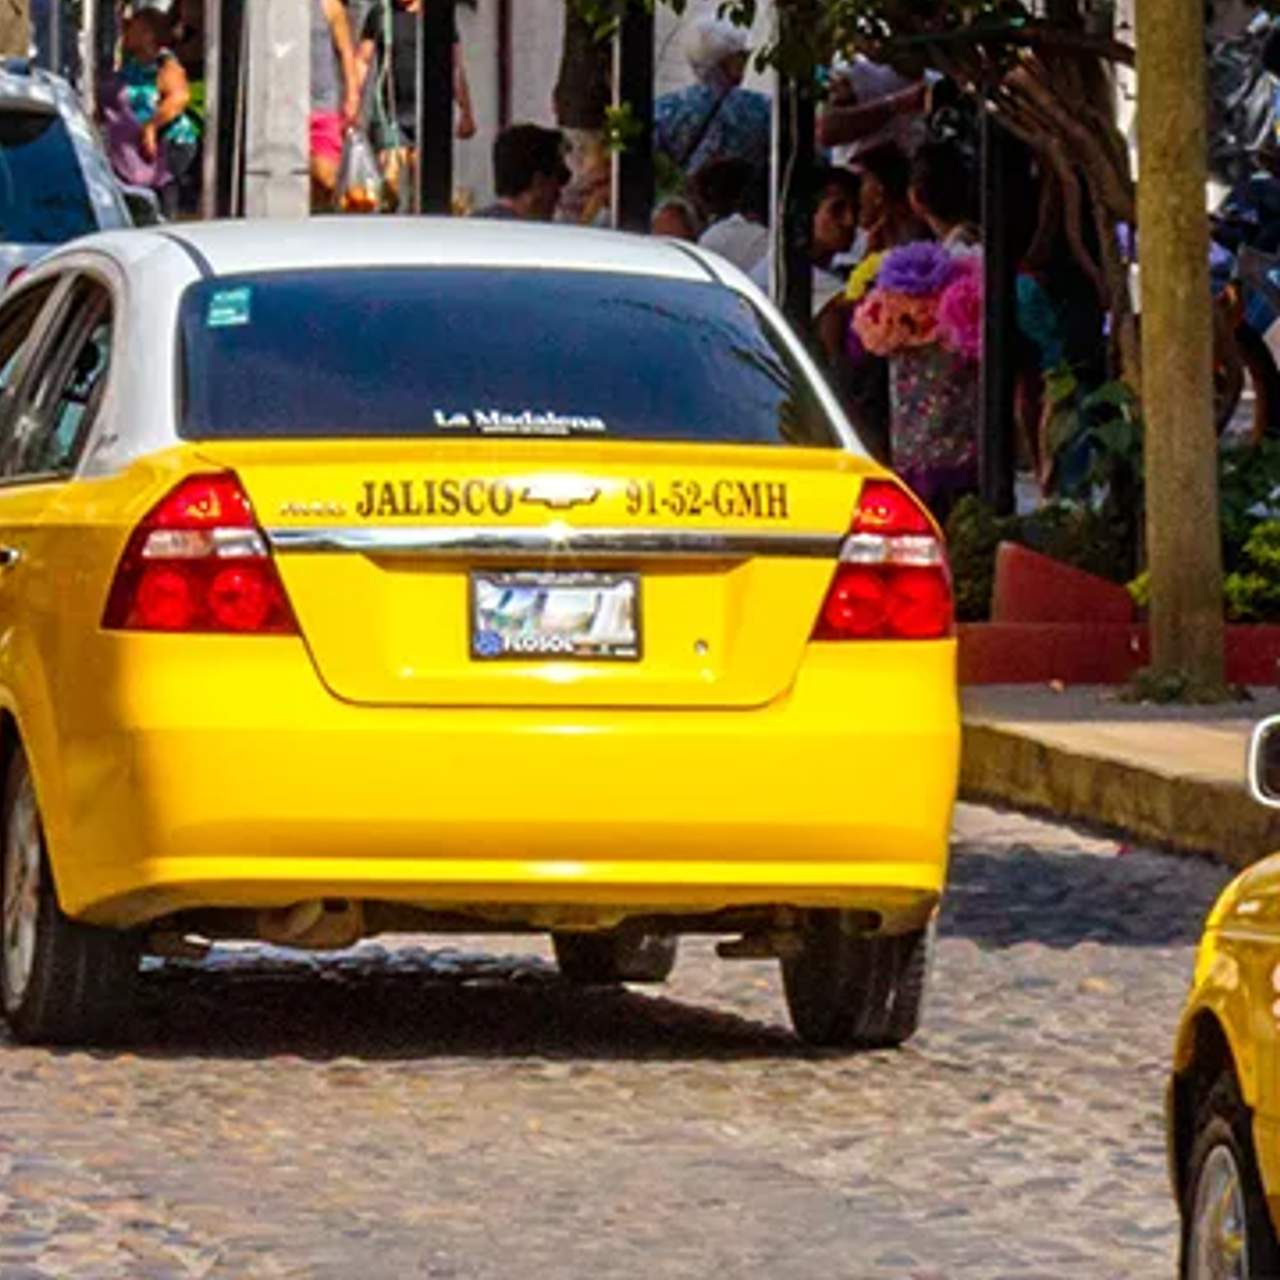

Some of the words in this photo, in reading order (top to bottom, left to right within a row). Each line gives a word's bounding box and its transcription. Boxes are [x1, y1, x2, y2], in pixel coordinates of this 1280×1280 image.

[433, 409, 471, 429] La
[355, 478, 515, 519] JALISCO
[625, 478, 789, 520] 91-52-GMH
